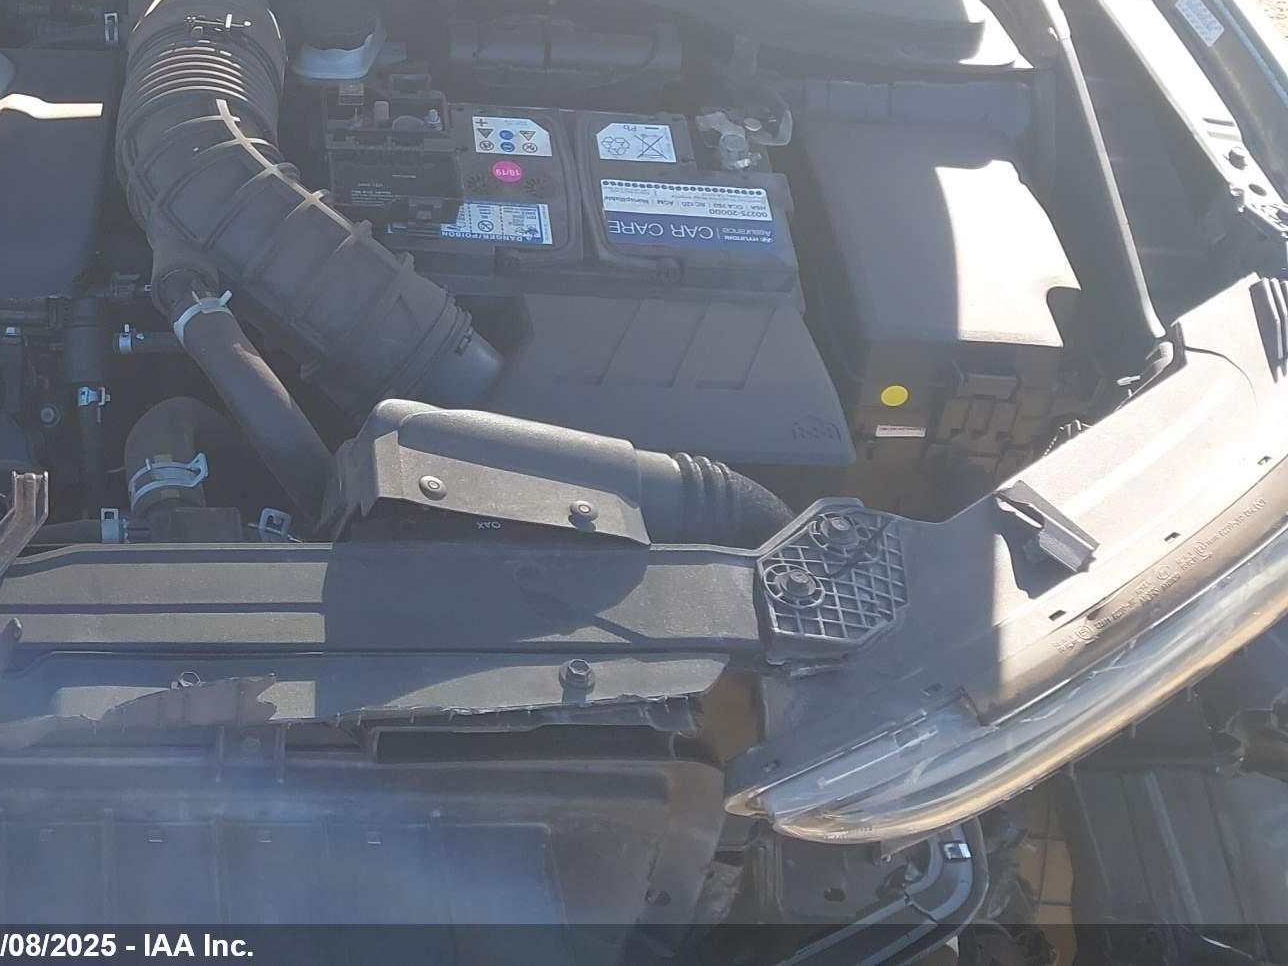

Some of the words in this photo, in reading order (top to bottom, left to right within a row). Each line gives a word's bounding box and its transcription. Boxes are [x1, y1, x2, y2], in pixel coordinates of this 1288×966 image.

[441, 230, 523, 242] DANGER/POISON
[608, 221, 664, 237] CARE
[670, 224, 714, 240] CAR
[722, 227, 772, 236] Assurance
